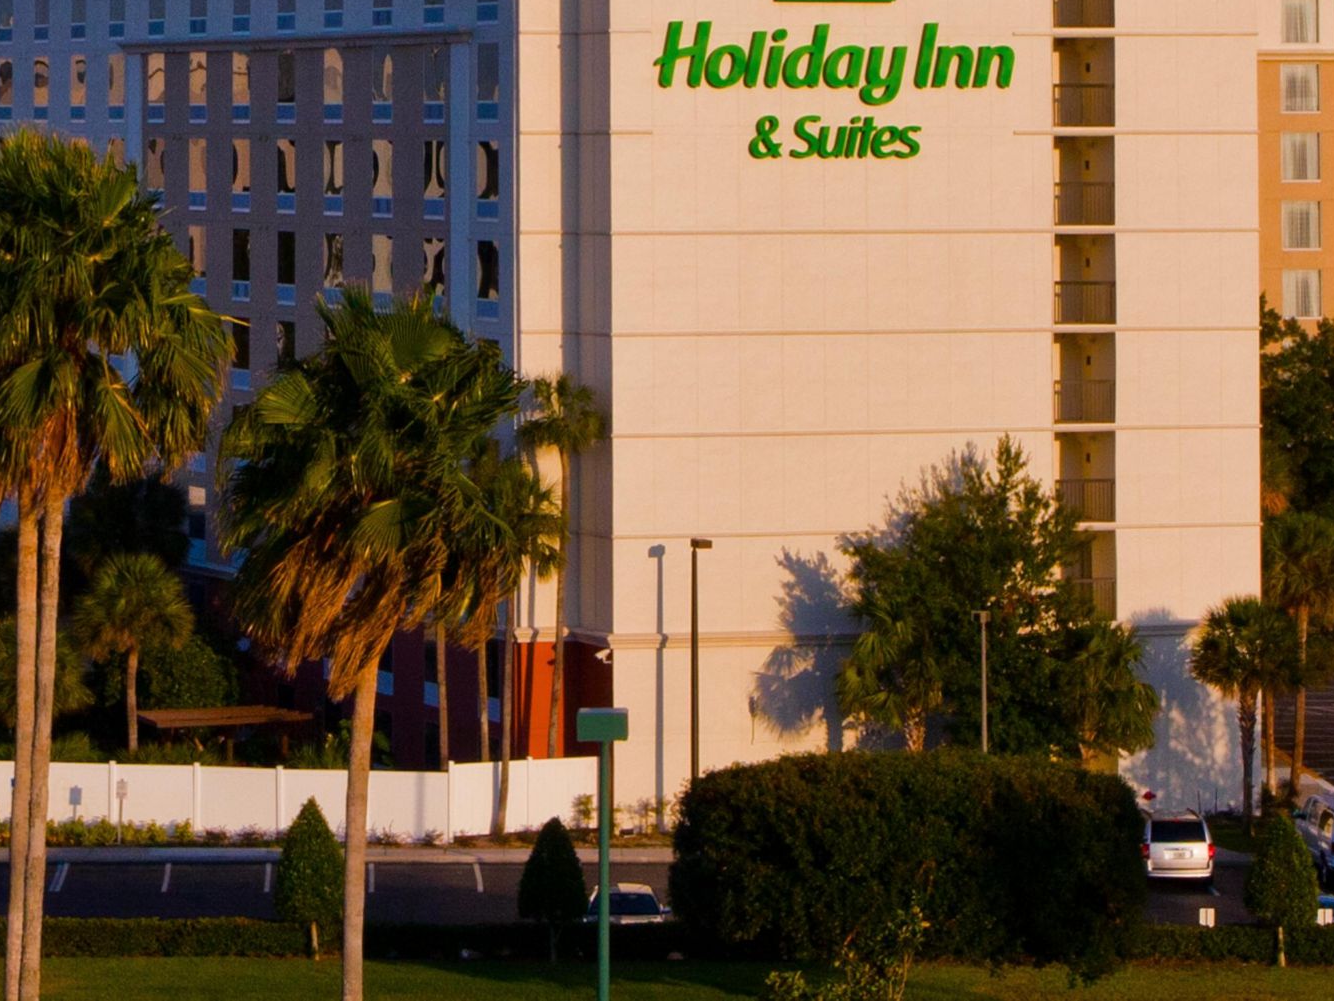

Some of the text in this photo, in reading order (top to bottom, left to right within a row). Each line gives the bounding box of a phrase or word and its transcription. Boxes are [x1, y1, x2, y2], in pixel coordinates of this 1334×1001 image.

[653, 20, 1015, 106] Holiday Inn
[748, 115, 922, 159] & Suites
